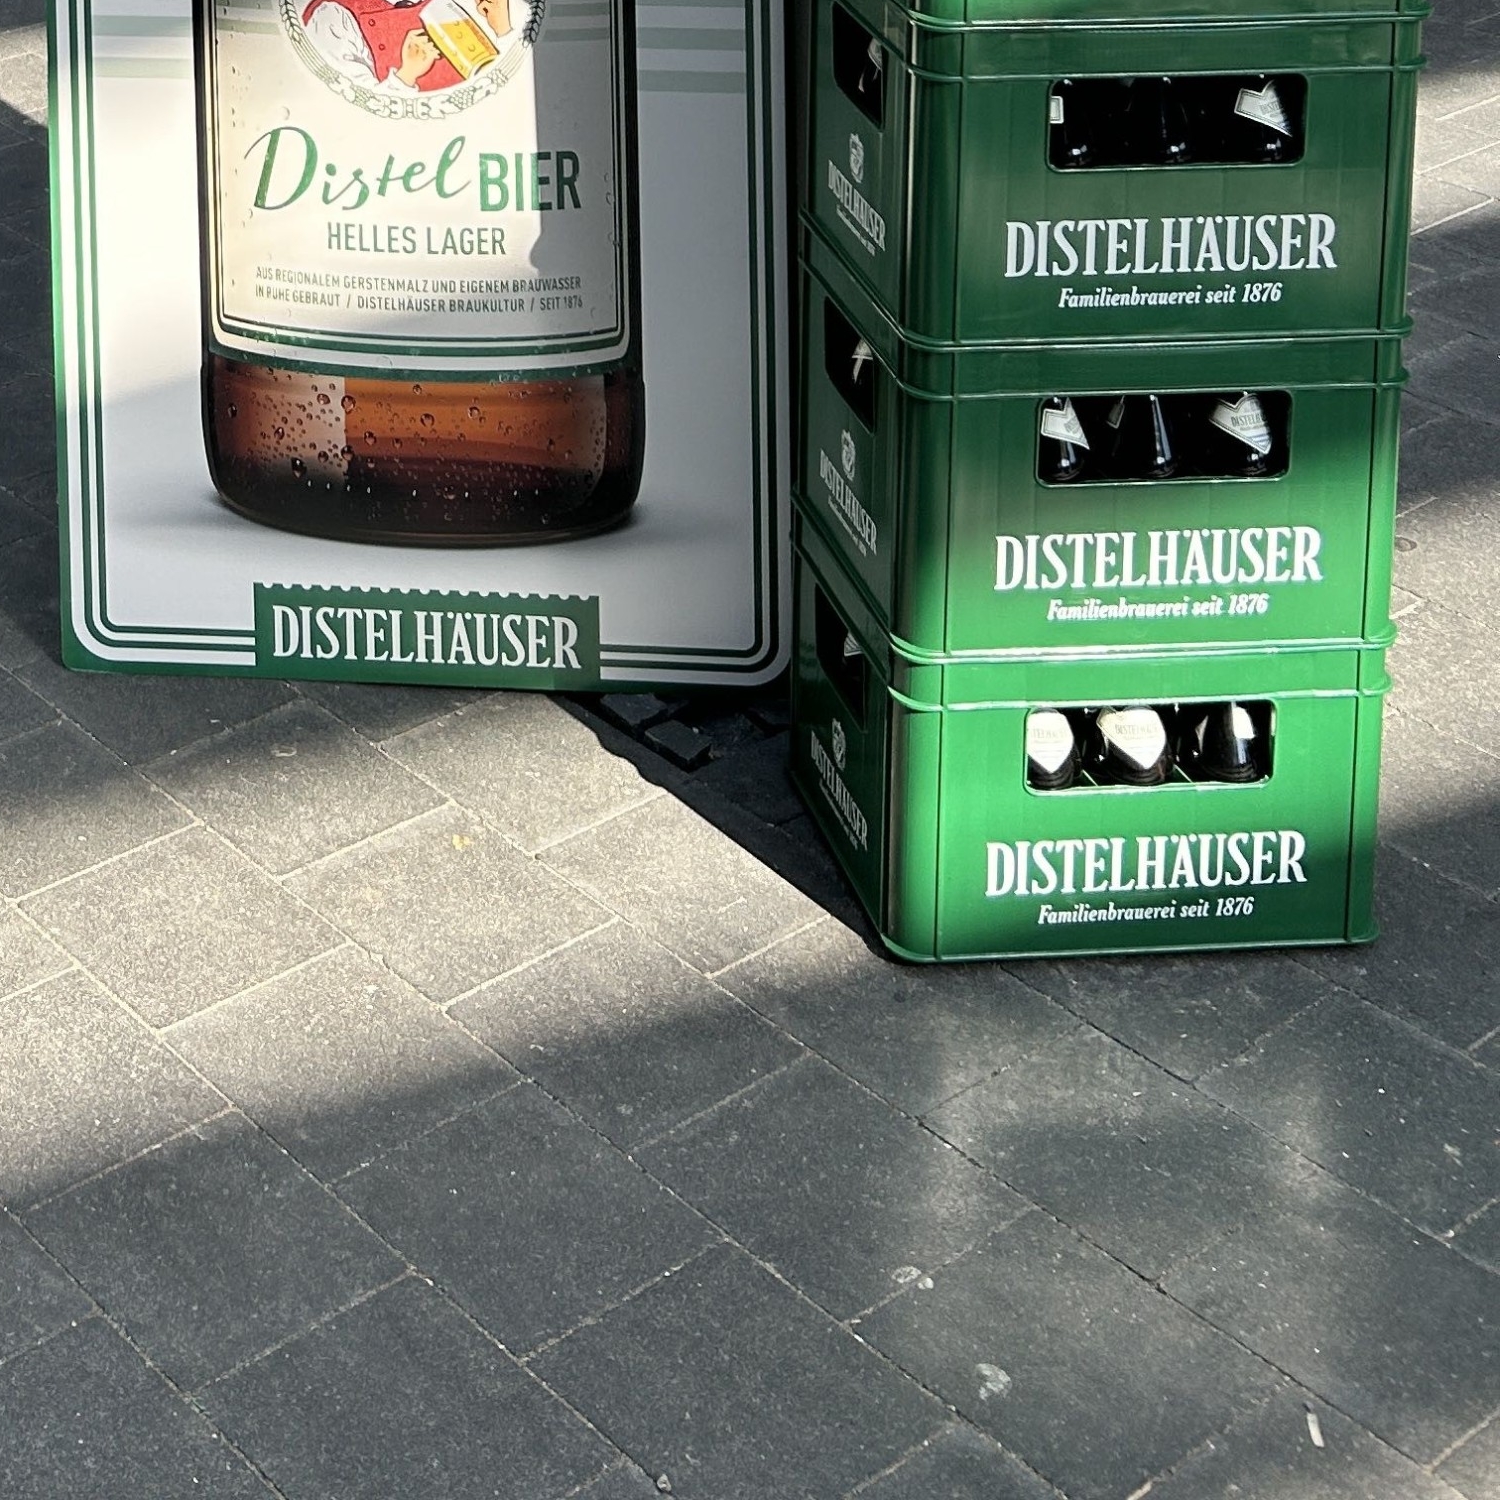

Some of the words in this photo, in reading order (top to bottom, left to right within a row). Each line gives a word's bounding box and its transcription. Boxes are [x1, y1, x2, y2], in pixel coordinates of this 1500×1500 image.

[244, 126, 472, 211] Distel
[479, 151, 582, 212] BIER
[327, 222, 417, 254] HELLES
[426, 227, 506, 256] LAGER
[1005, 214, 1337, 278] DISTELHÄUSER
[256, 266, 273, 281] AUS
[275, 268, 340, 288] REGIONALEM
[343, 275, 428, 293] GERSTENMALZ
[431, 280, 456, 293] UND
[460, 279, 509, 293] EIGENEM
[512, 276, 582, 293] BRAUWASSER
[1058, 284, 1202, 308] Familienbrauerei
[1205, 284, 1237, 305] seit
[1241, 282, 1283, 302] 1876
[255, 284, 264, 298] IN
[292, 289, 340, 307] GEBRAUT
[357, 294, 445, 312] DISTELHÄUSER
[449, 299, 525, 313] BRAUKULTUR
[540, 296, 561, 311] SEIT
[994, 527, 1323, 591] DISTELHÄUSER
[1047, 596, 1189, 621] Familienbrauerei
[1191, 596, 1223, 617] seit
[1228, 593, 1268, 615] 1876
[272, 605, 582, 669] DISTELHÄUSER
[985, 831, 1307, 897] DISTELHÄUSER
[1037, 901, 1176, 925] Familienbrauerei
[1180, 899, 1210, 919] seit
[1214, 896, 1254, 917] 1876
